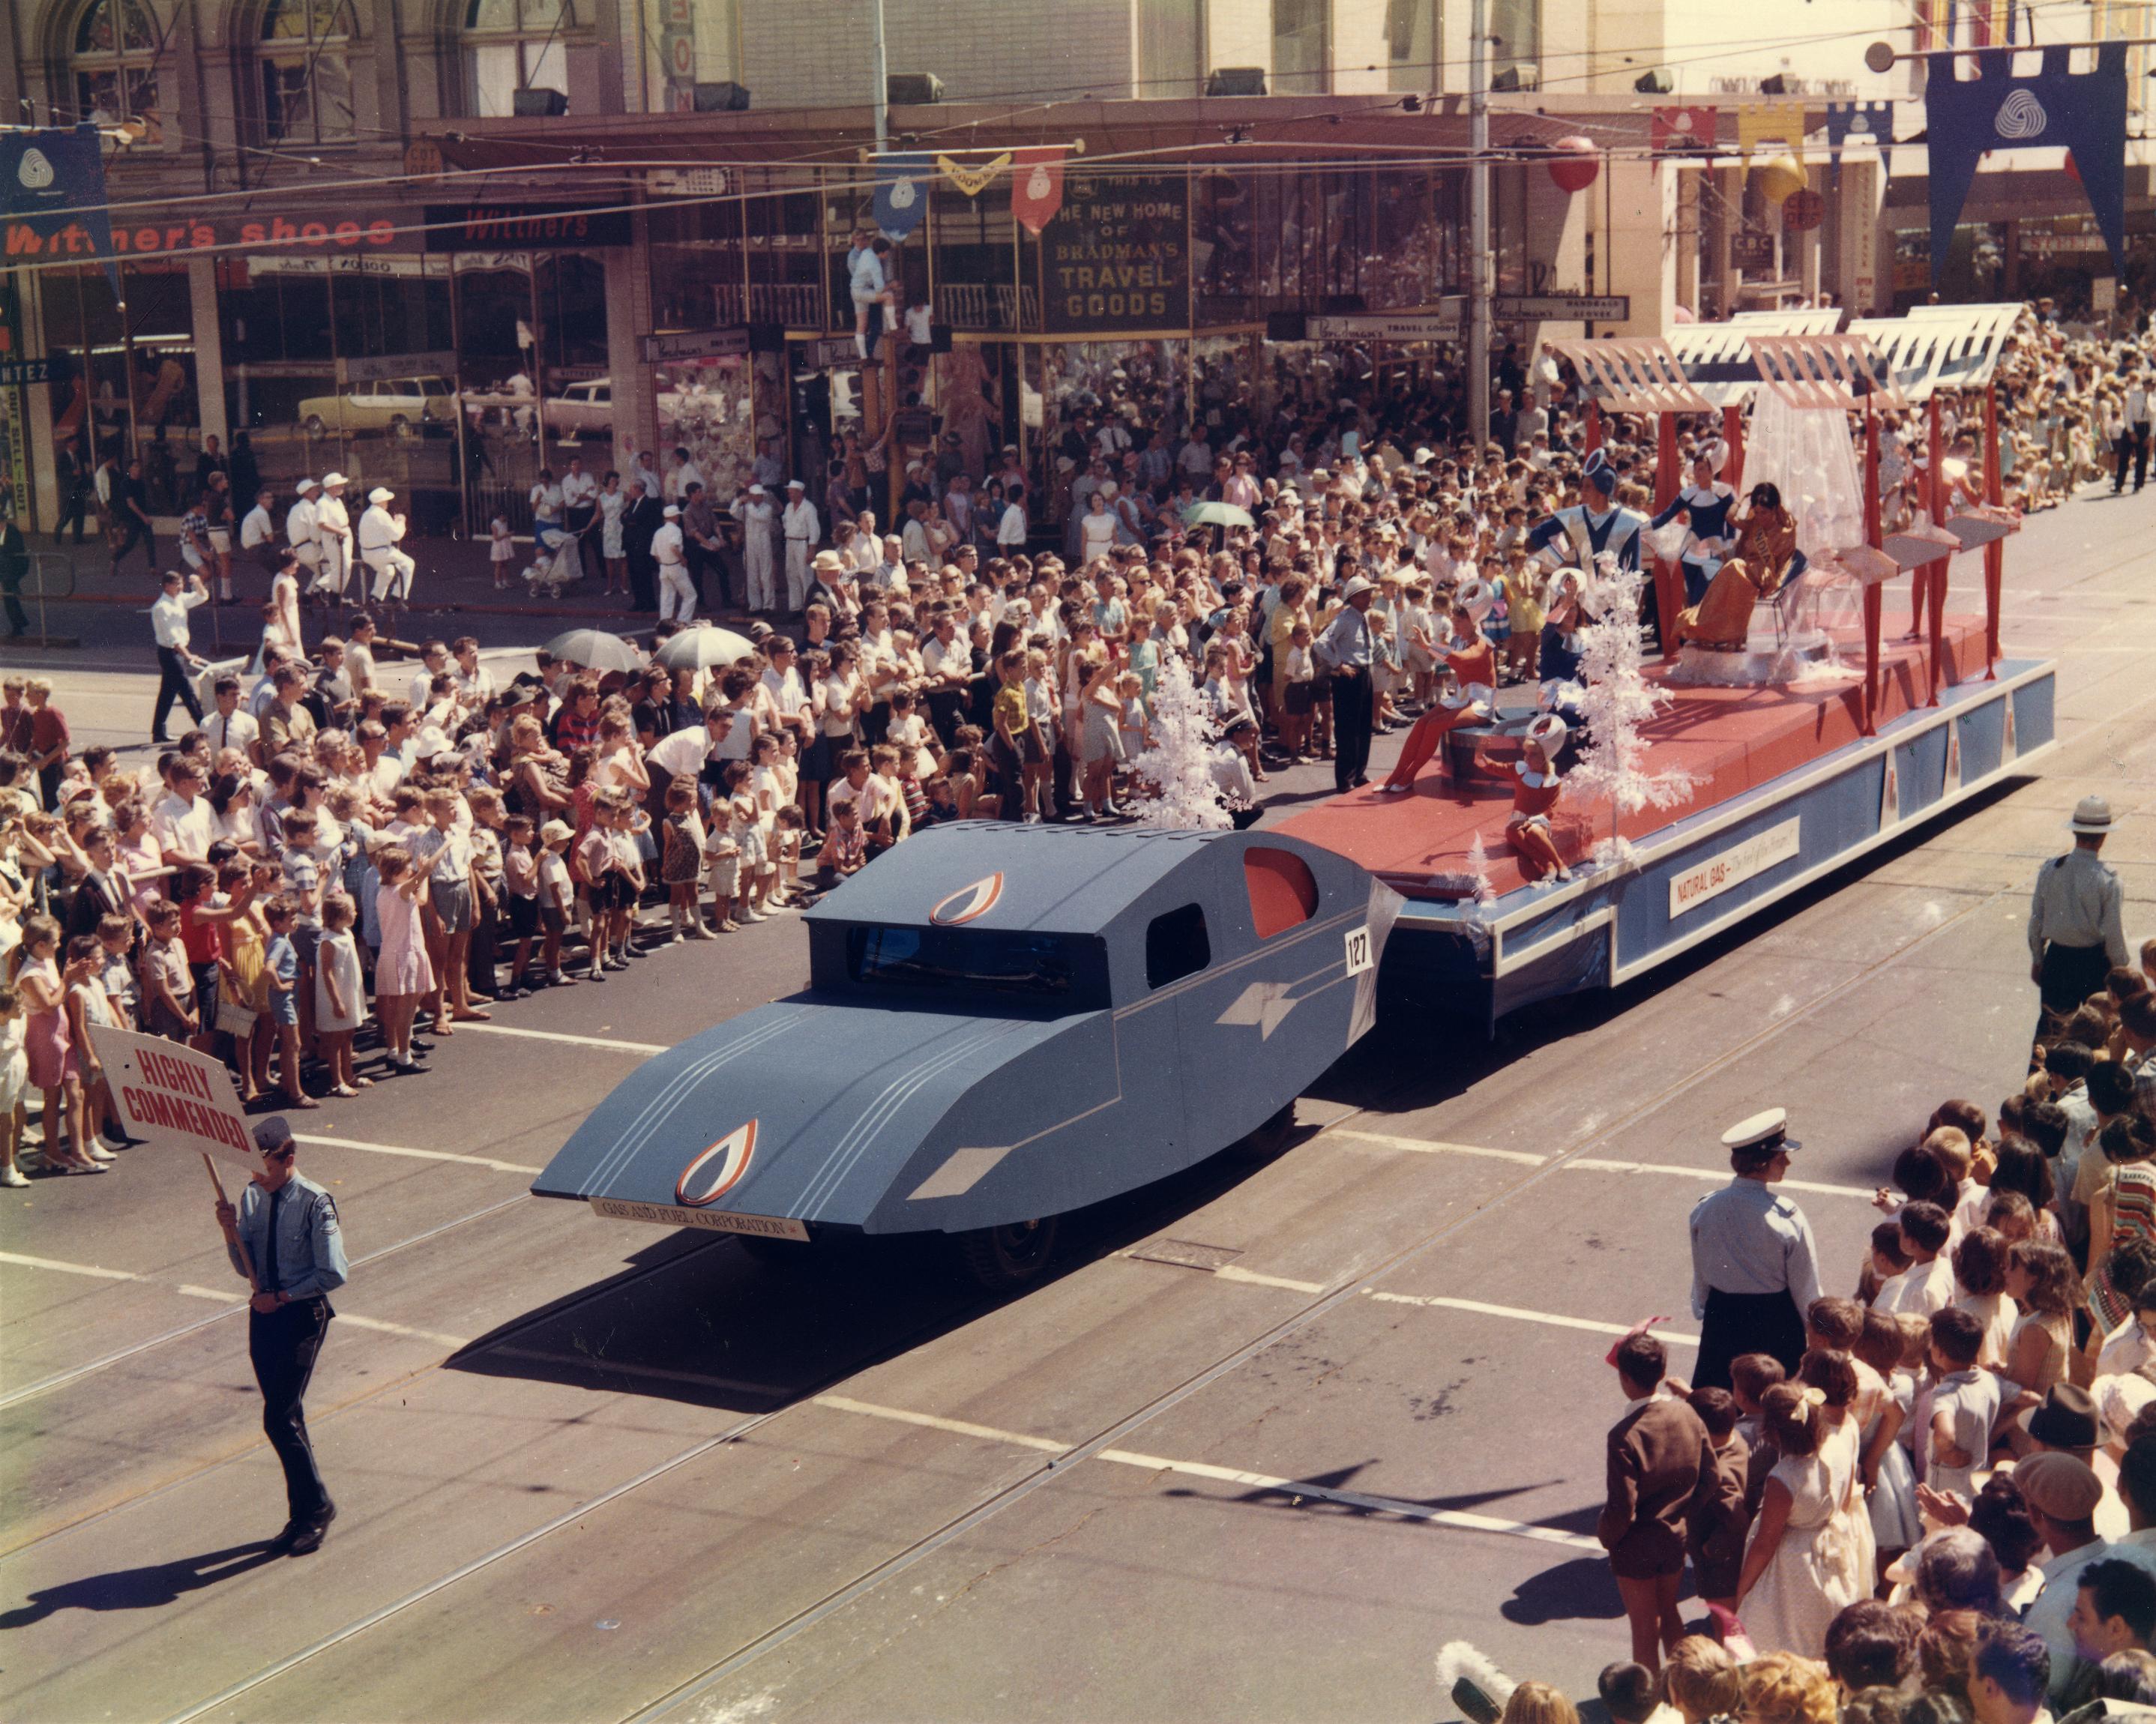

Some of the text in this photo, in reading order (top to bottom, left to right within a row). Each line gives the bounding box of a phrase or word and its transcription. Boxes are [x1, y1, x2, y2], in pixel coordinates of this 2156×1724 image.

[1059, 202, 1182, 222] HE NEW HOME
[240, 217, 394, 246] shoes
[1100, 225, 1129, 237] OF
[1056, 242, 1178, 261] BRADMAN'S
[1059, 265, 1173, 289] TRAVEL
[1068, 292, 1166, 317] GOODS
[1387, 324, 1423, 332] TRAVEL
[1427, 324, 1457, 332] GOODS
[1677, 871, 1708, 904] NATURAL
[1349, 933, 1366, 968] 127
[135, 1049, 214, 1103] HIGHLY
[121, 1085, 251, 1153] COMMENDED
[602, 1202, 786, 1235] GAS AND FUEL CORPORATION
